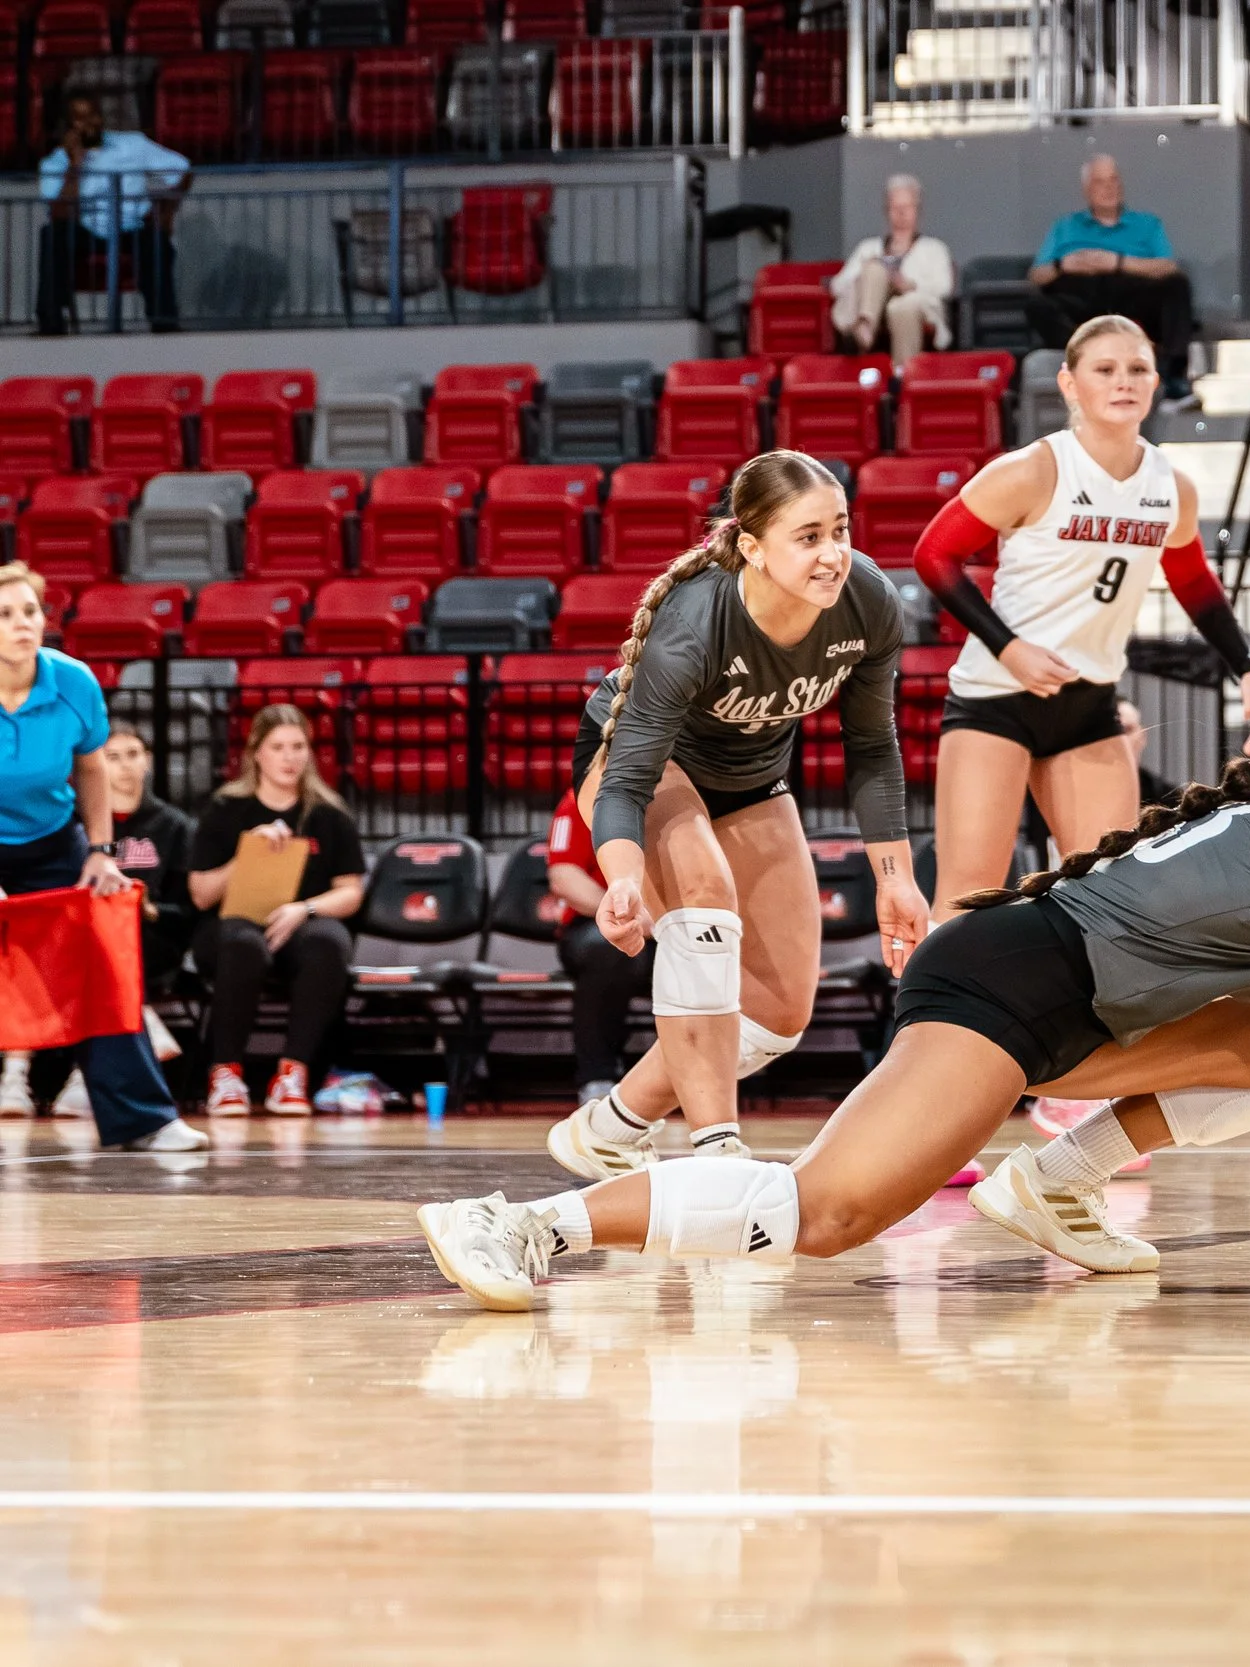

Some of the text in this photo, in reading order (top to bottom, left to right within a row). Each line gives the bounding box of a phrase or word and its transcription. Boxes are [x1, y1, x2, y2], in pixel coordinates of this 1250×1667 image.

[1057, 514, 1112, 542] JAX
[1093, 556, 1128, 604] 9
[713, 685, 777, 720] Jax
